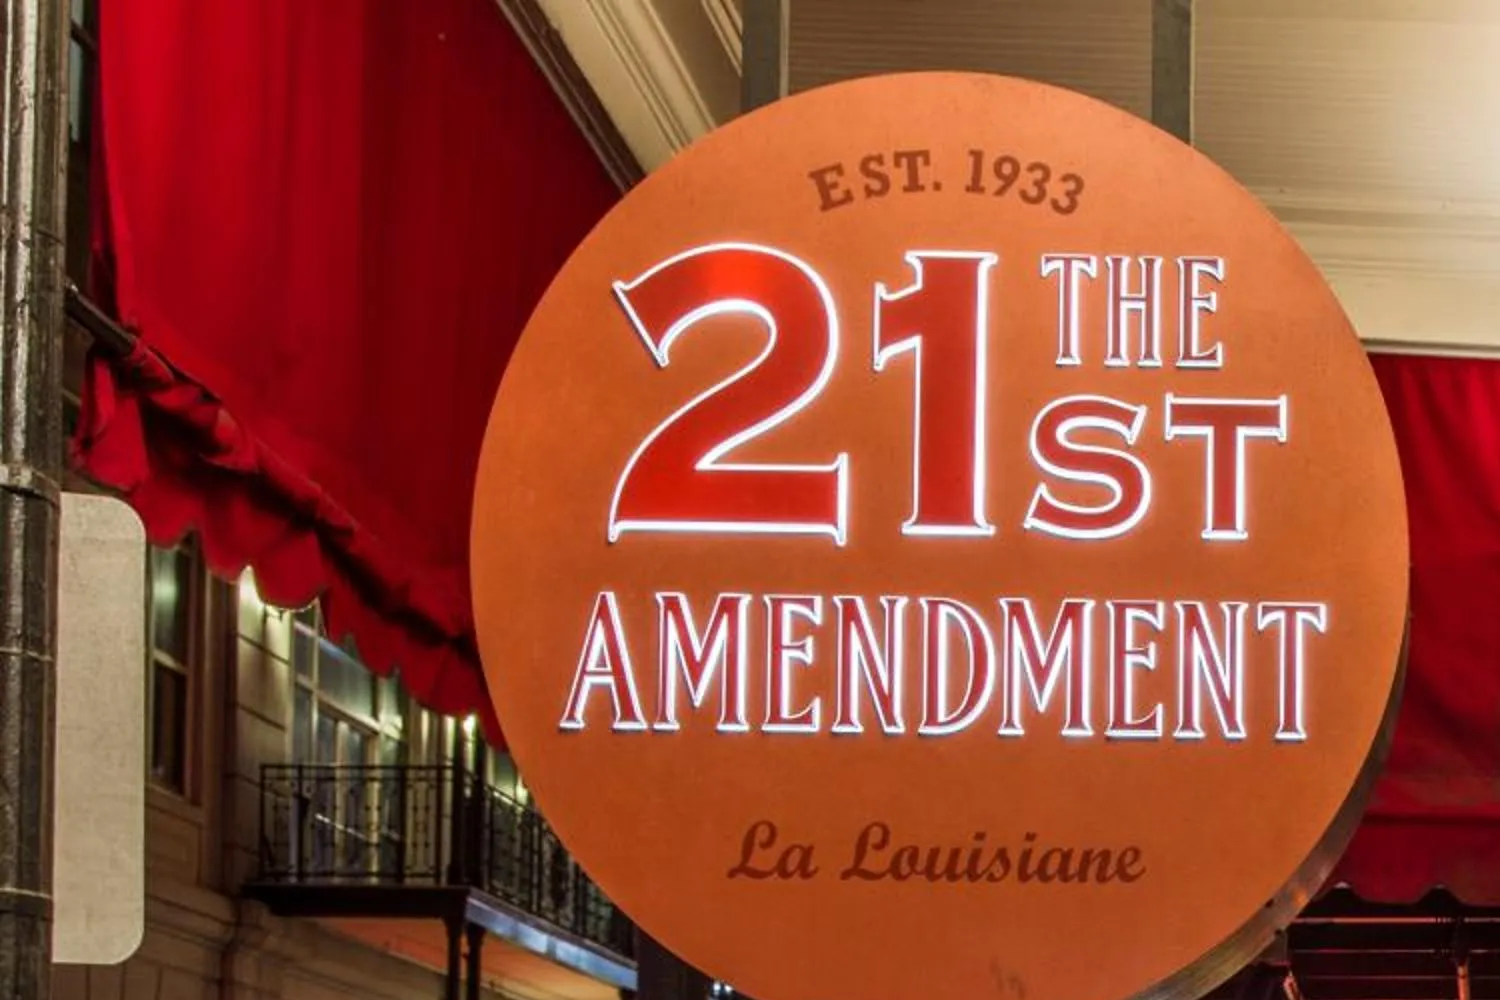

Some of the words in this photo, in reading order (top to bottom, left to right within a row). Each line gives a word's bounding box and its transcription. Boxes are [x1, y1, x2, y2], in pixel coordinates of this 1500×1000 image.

[808, 148, 943, 213] EST.
[965, 149, 1085, 216] 1933
[1040, 253, 1225, 370] THE
[558, 590, 1328, 742] AMENDMENT
[726, 819, 819, 881] La
[839, 820, 1147, 884] Louisiane
